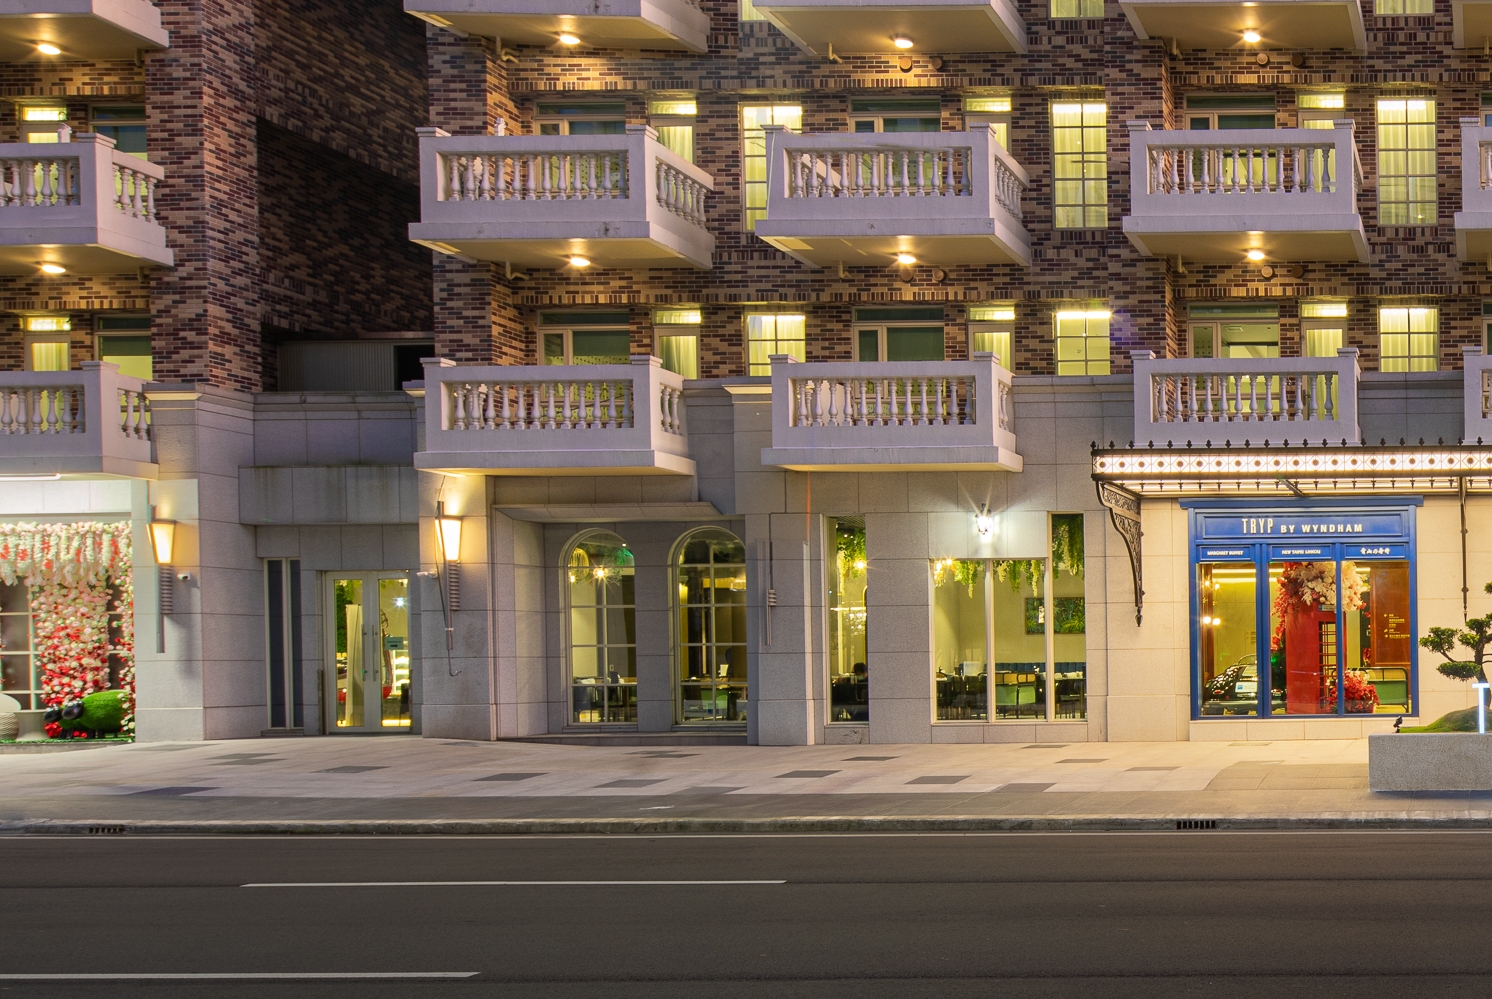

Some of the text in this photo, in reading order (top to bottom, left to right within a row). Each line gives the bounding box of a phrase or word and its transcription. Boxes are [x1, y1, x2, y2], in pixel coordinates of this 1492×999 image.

[1241, 518, 1363, 534] TRYP BY WYNDHAM
